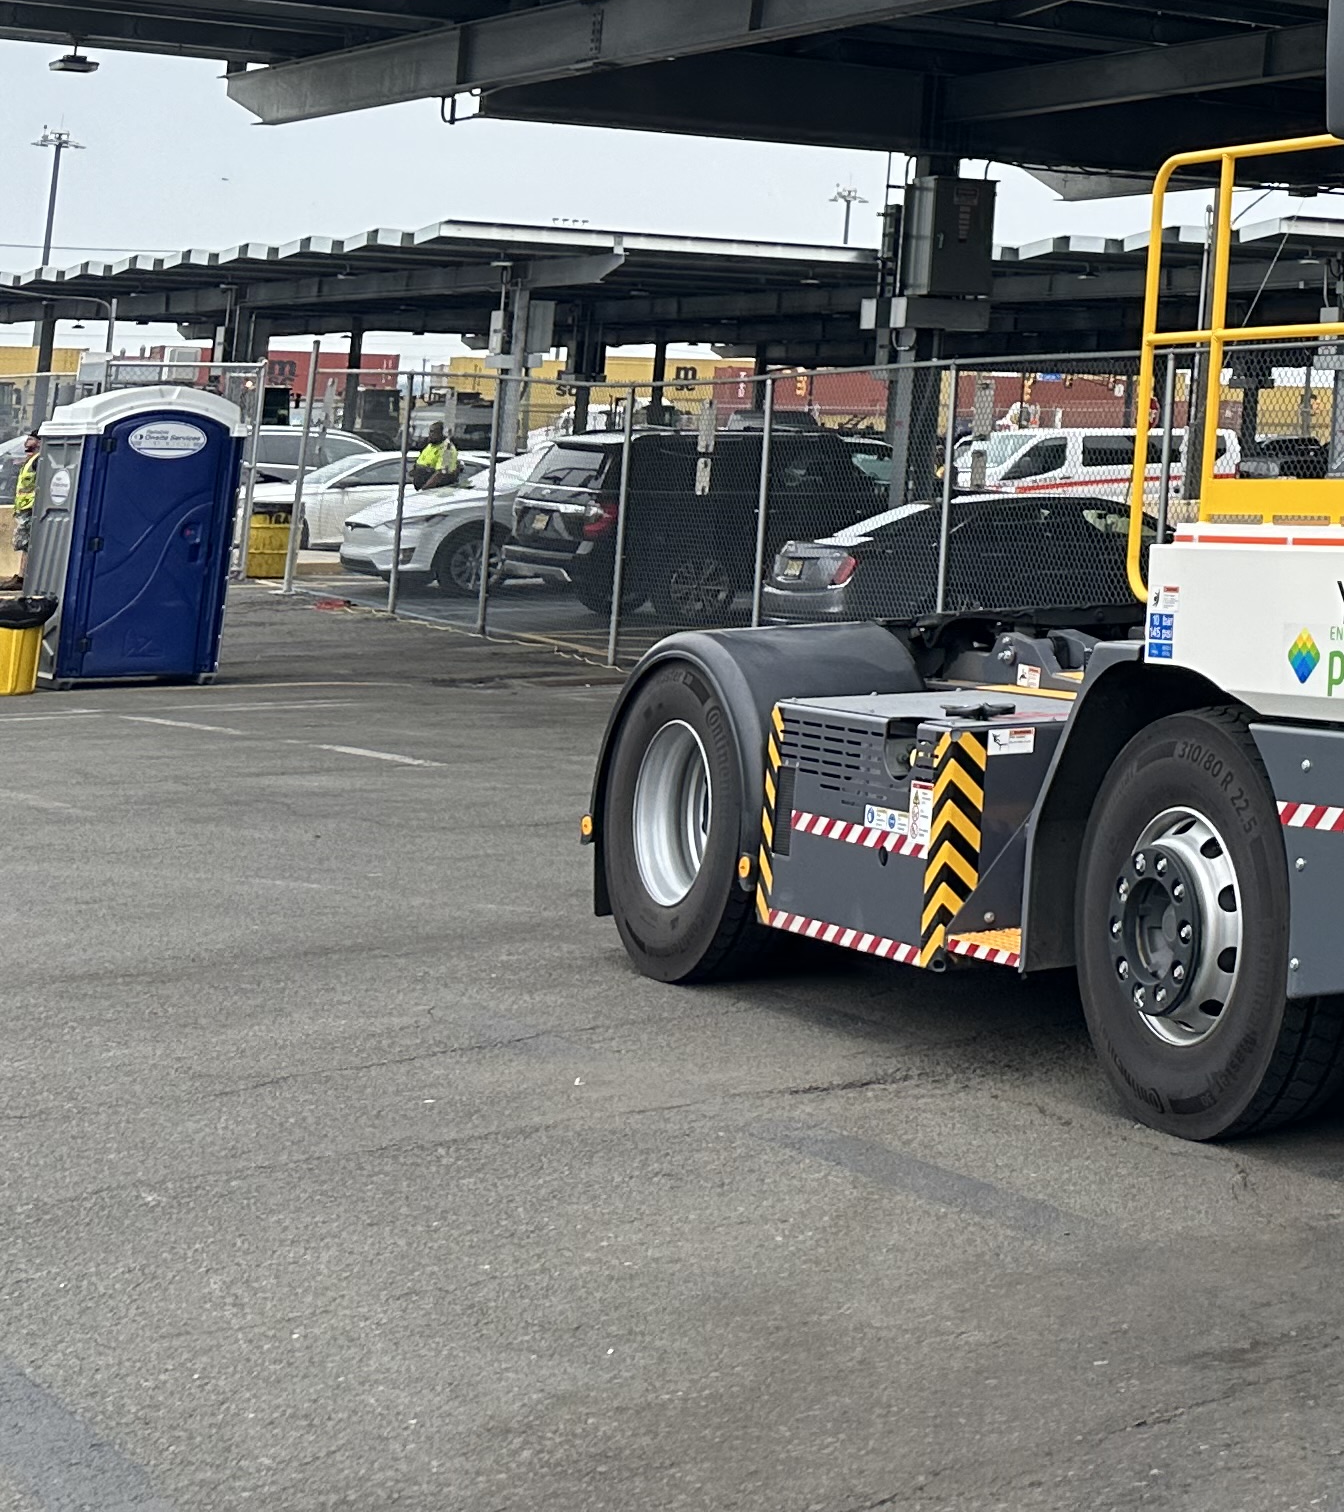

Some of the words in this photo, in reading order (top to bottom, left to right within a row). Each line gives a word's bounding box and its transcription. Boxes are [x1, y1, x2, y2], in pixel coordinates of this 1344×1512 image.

[1178, 741, 1223, 778] 310/80
[1221, 771, 1234, 792] R
[1231, 788, 1258, 833] 22.5
